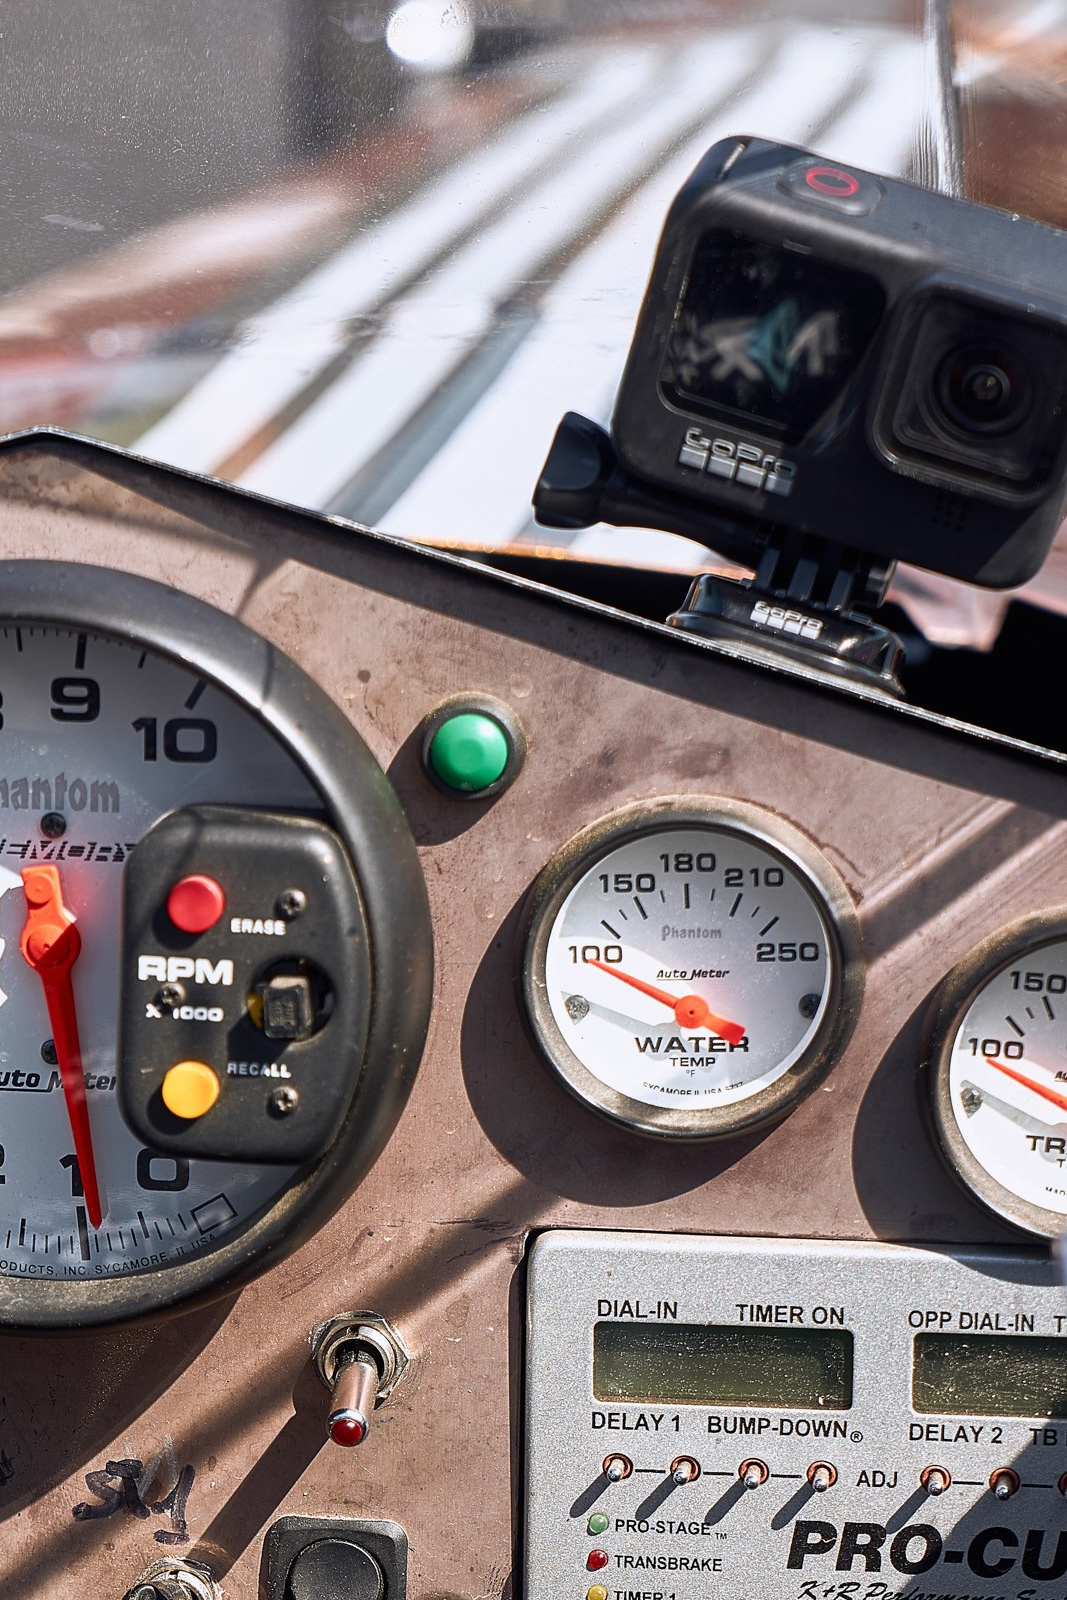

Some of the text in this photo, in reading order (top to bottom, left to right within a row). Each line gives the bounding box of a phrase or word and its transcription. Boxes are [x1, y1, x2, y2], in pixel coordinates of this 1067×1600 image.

[685, 426, 798, 478] GoPro
[754, 600, 823, 631] GoPro
[50, 677, 101, 722] 9
[131, 715, 217, 763] 10
[659, 853, 717, 873] 180
[598, 873, 655, 894] 150
[723, 867, 785, 888] 210
[230, 918, 286, 936] ERASE
[661, 925, 721, 941] Phantom
[568, 944, 623, 964] 100
[756, 942, 819, 962] 250
[138, 955, 234, 986] RPM
[656, 969, 730, 980] Auto Meter
[1009, 970, 1067, 995] 150
[634, 1037, 749, 1053] WATER
[967, 1037, 1024, 1060] 100
[227, 1062, 292, 1078] RECALL
[669, 1057, 716, 1067] TEMP
[59, 1154, 85, 1197] 1
[137, 1147, 189, 1192] 0
[597, 1299, 844, 1325] DIAL-IN TIMER ON
[908, 1310, 952, 1329] OPP
[958, 1312, 1034, 1332] DIAL-IN
[591, 1412, 664, 1432] DELAY
[671, 1415, 680, 1432] 1
[909, 1423, 984, 1443] DELAY
[991, 1427, 1003, 1444] 2
[1029, 1428, 1058, 1446] TB
[856, 1470, 898, 1489] ADJ
[615, 1519, 711, 1536] PRO-STAGE
[614, 1555, 722, 1572] TRANSBRAKE
